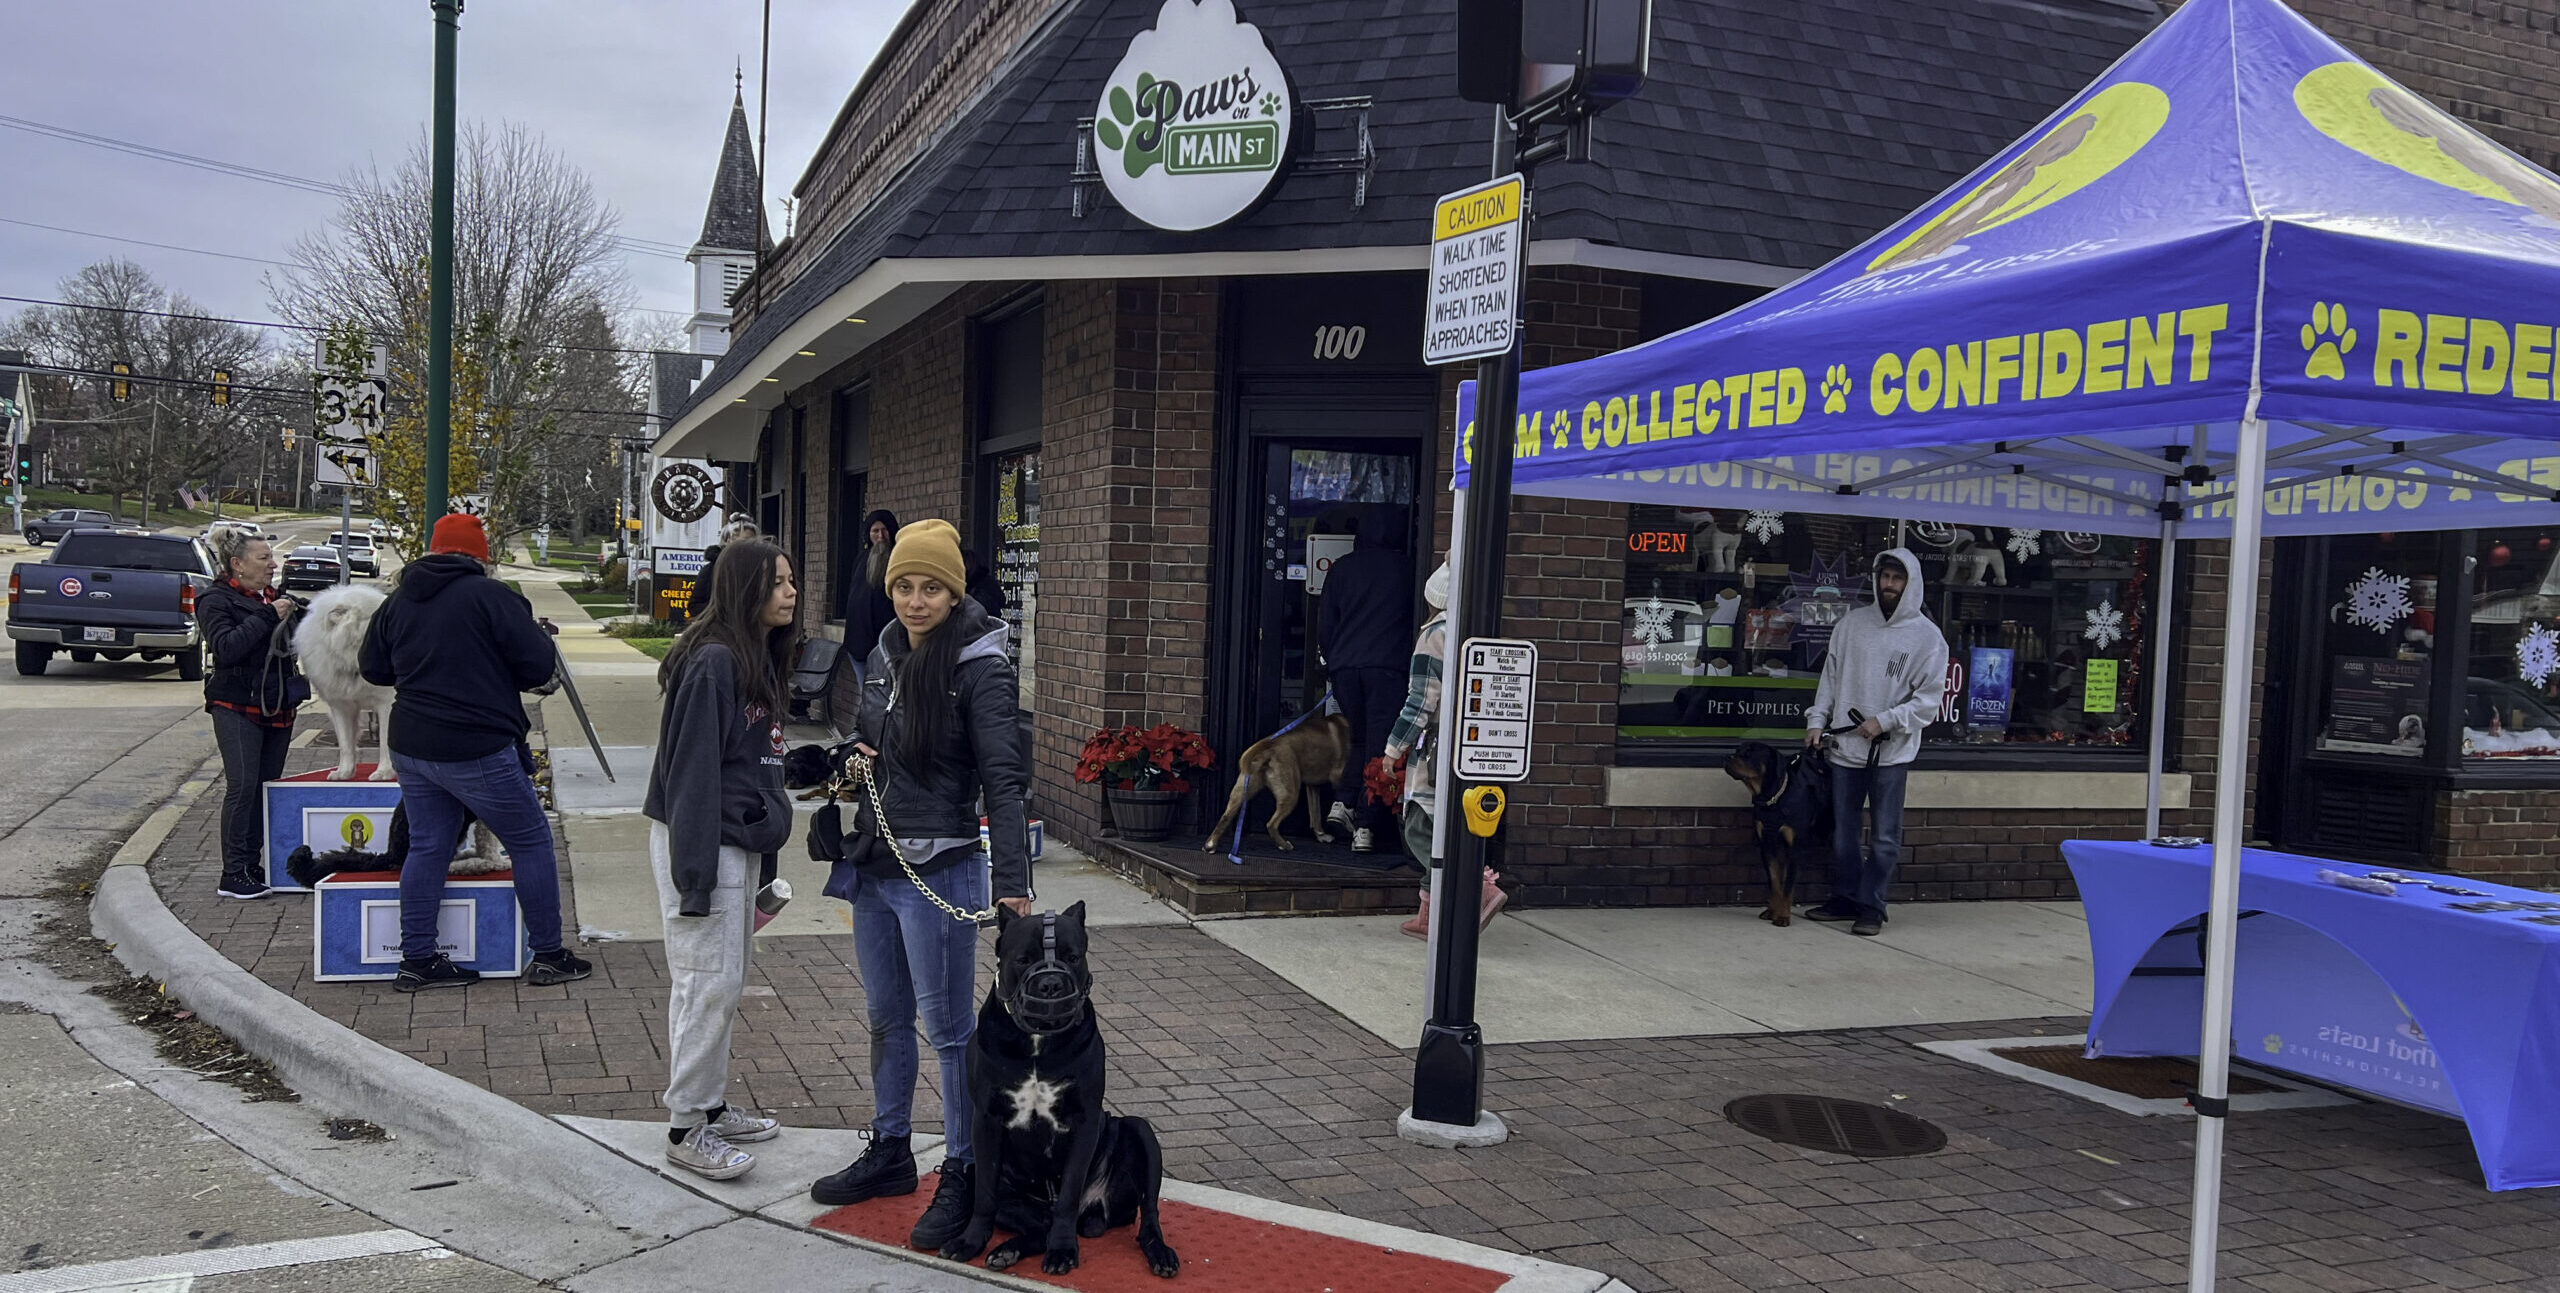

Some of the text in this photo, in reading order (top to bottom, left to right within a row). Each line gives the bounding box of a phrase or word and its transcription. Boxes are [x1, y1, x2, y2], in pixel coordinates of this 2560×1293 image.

[1136, 66, 1260, 151] Paws
[1232, 106, 1250, 119] on
[1178, 132, 1265, 166] MAIN ST
[1449, 192, 1506, 230] CAUTION
[1443, 231, 1506, 266] WALK TIME
[1438, 261, 1506, 295] SHORTENED
[1435, 290, 1506, 324] WHEN TRAIN
[1313, 325, 1366, 360] 100
[1429, 319, 1508, 352] APPROACHES
[2373, 308, 2560, 401] REDE
[1462, 303, 2229, 464] CM COLLECTED CONFIDENT
[323, 389, 378, 428] 34
[661, 553, 704, 562] AMERIC
[1629, 532, 1686, 552] OPEN
[670, 562, 702, 571] LEGIO
[1970, 697, 2006, 712] FROZEN
[1488, 763, 1506, 771] CROSS
